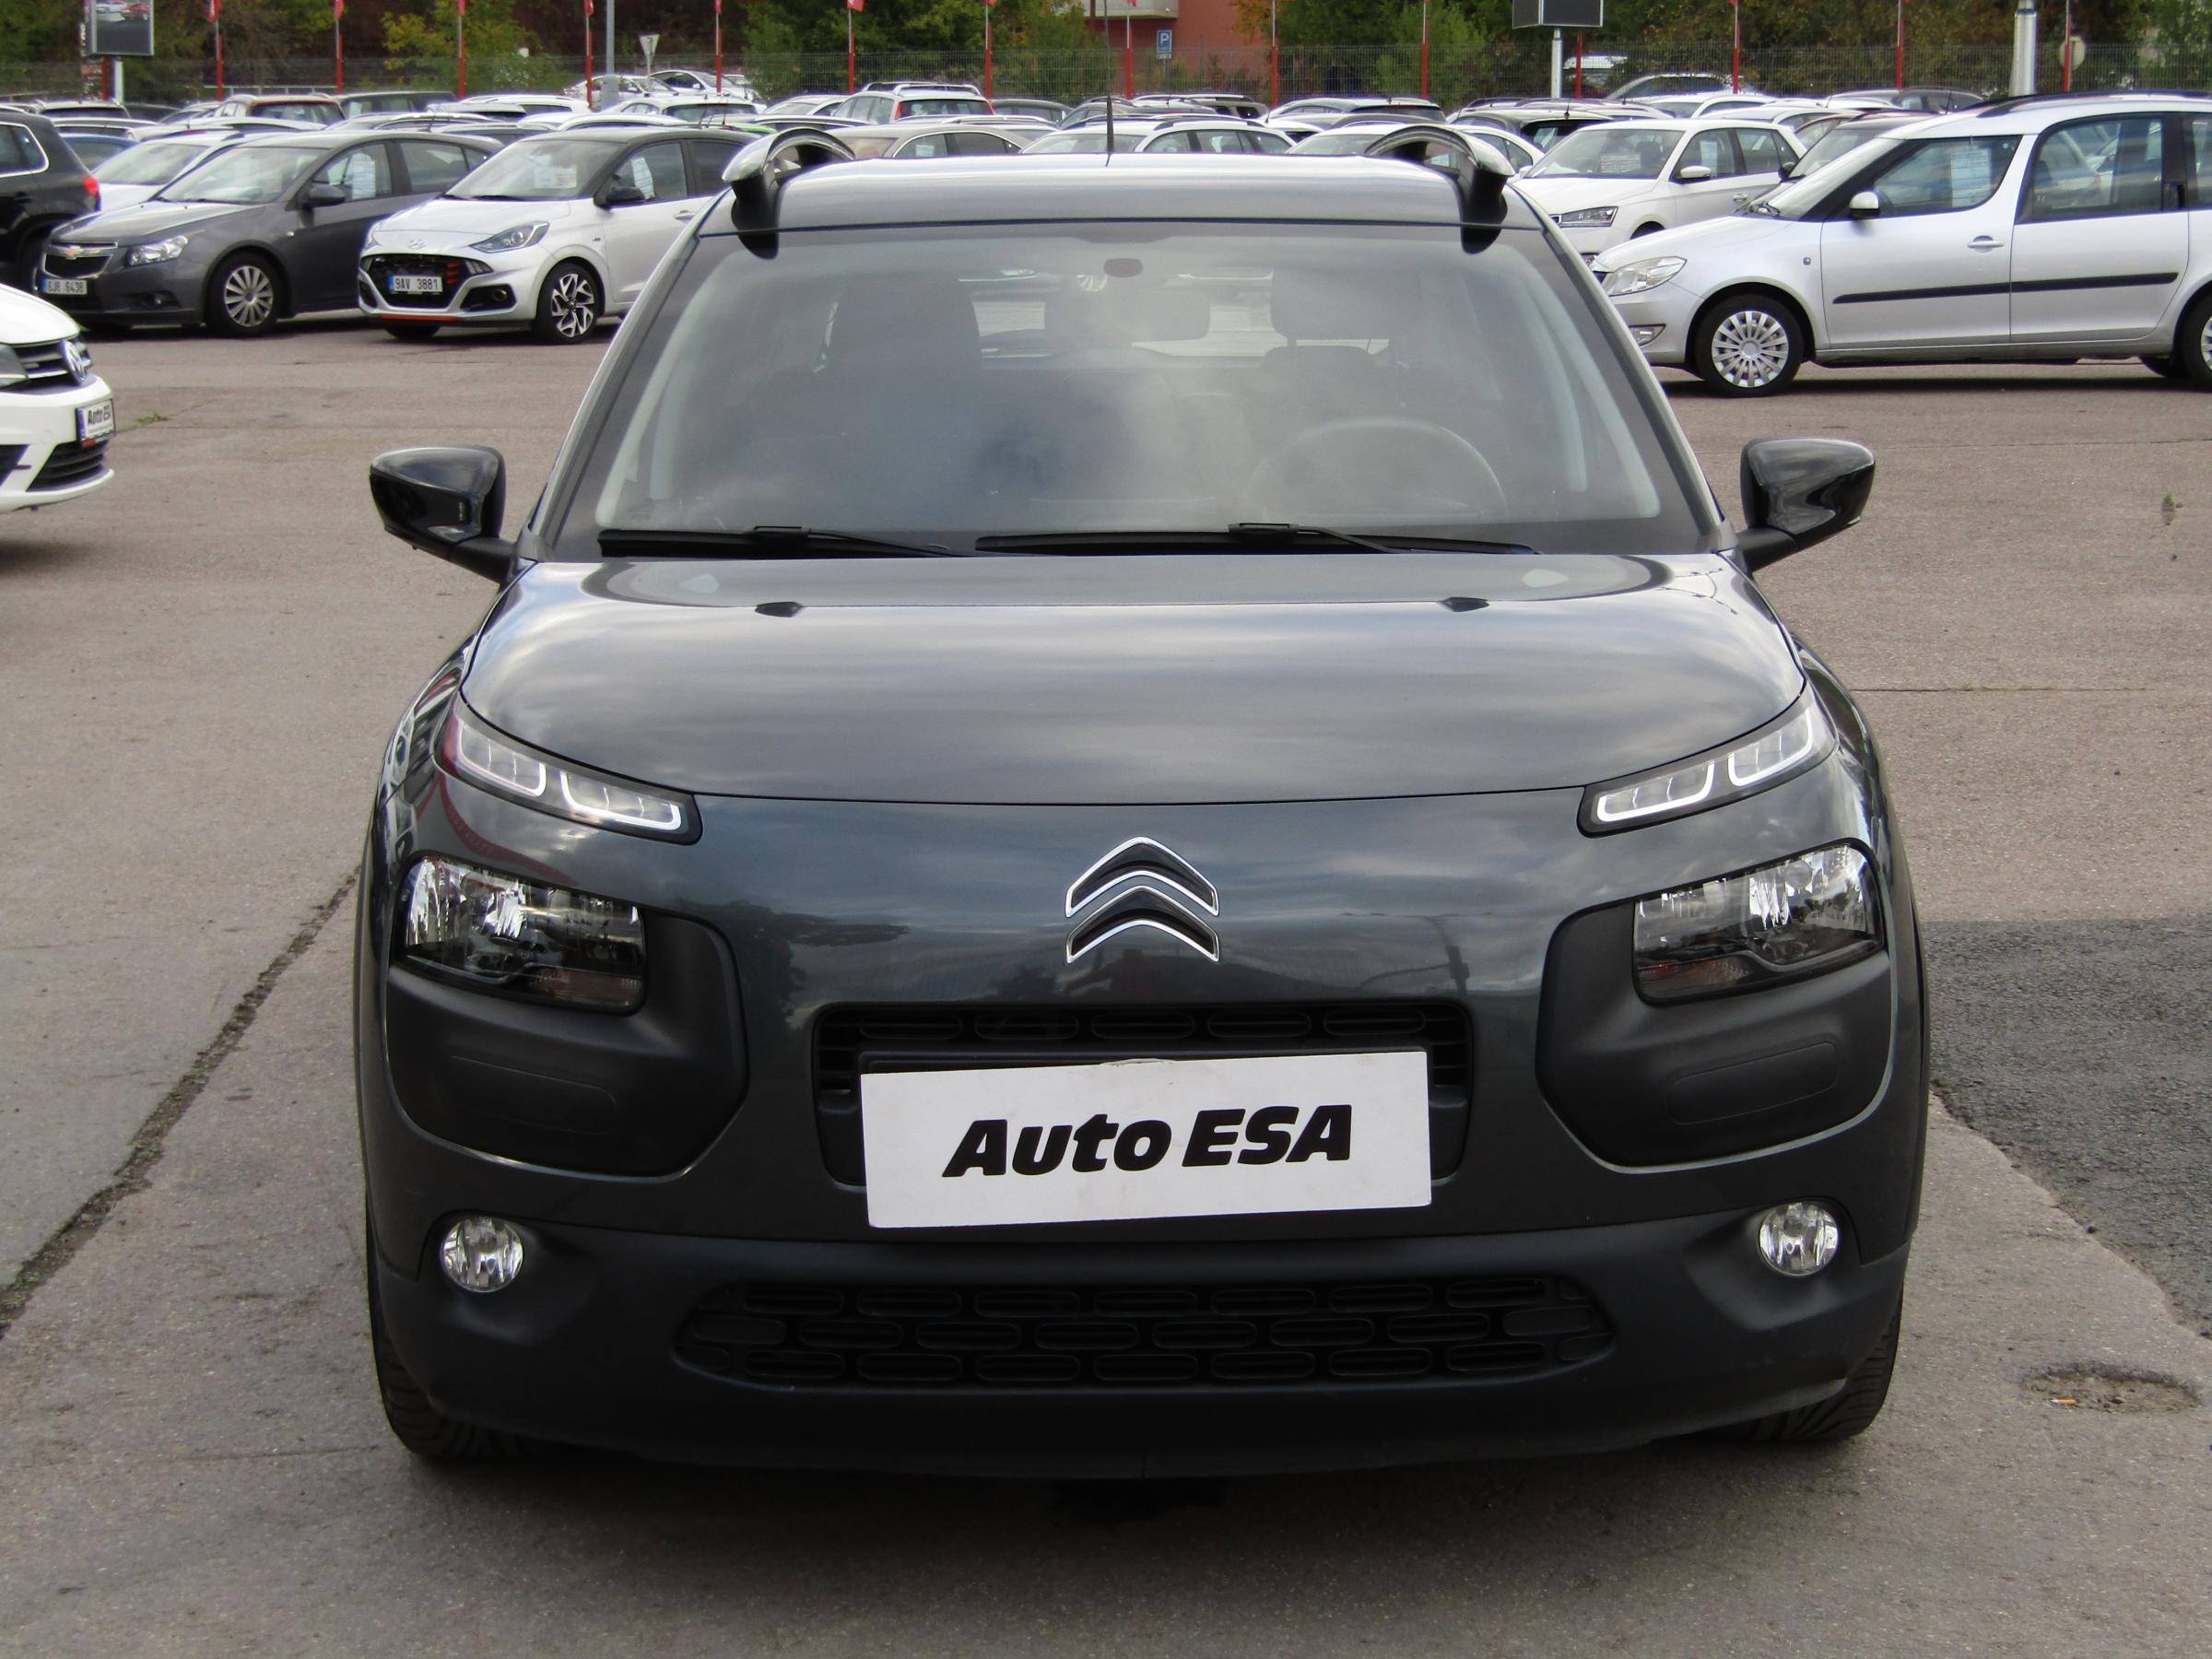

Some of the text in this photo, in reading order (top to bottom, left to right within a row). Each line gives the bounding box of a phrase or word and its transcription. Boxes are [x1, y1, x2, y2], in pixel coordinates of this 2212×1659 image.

[1160, 32, 1169, 46] P
[395, 277, 439, 291] 9AV 3881
[942, 1104, 1352, 1177] Auto ESA
